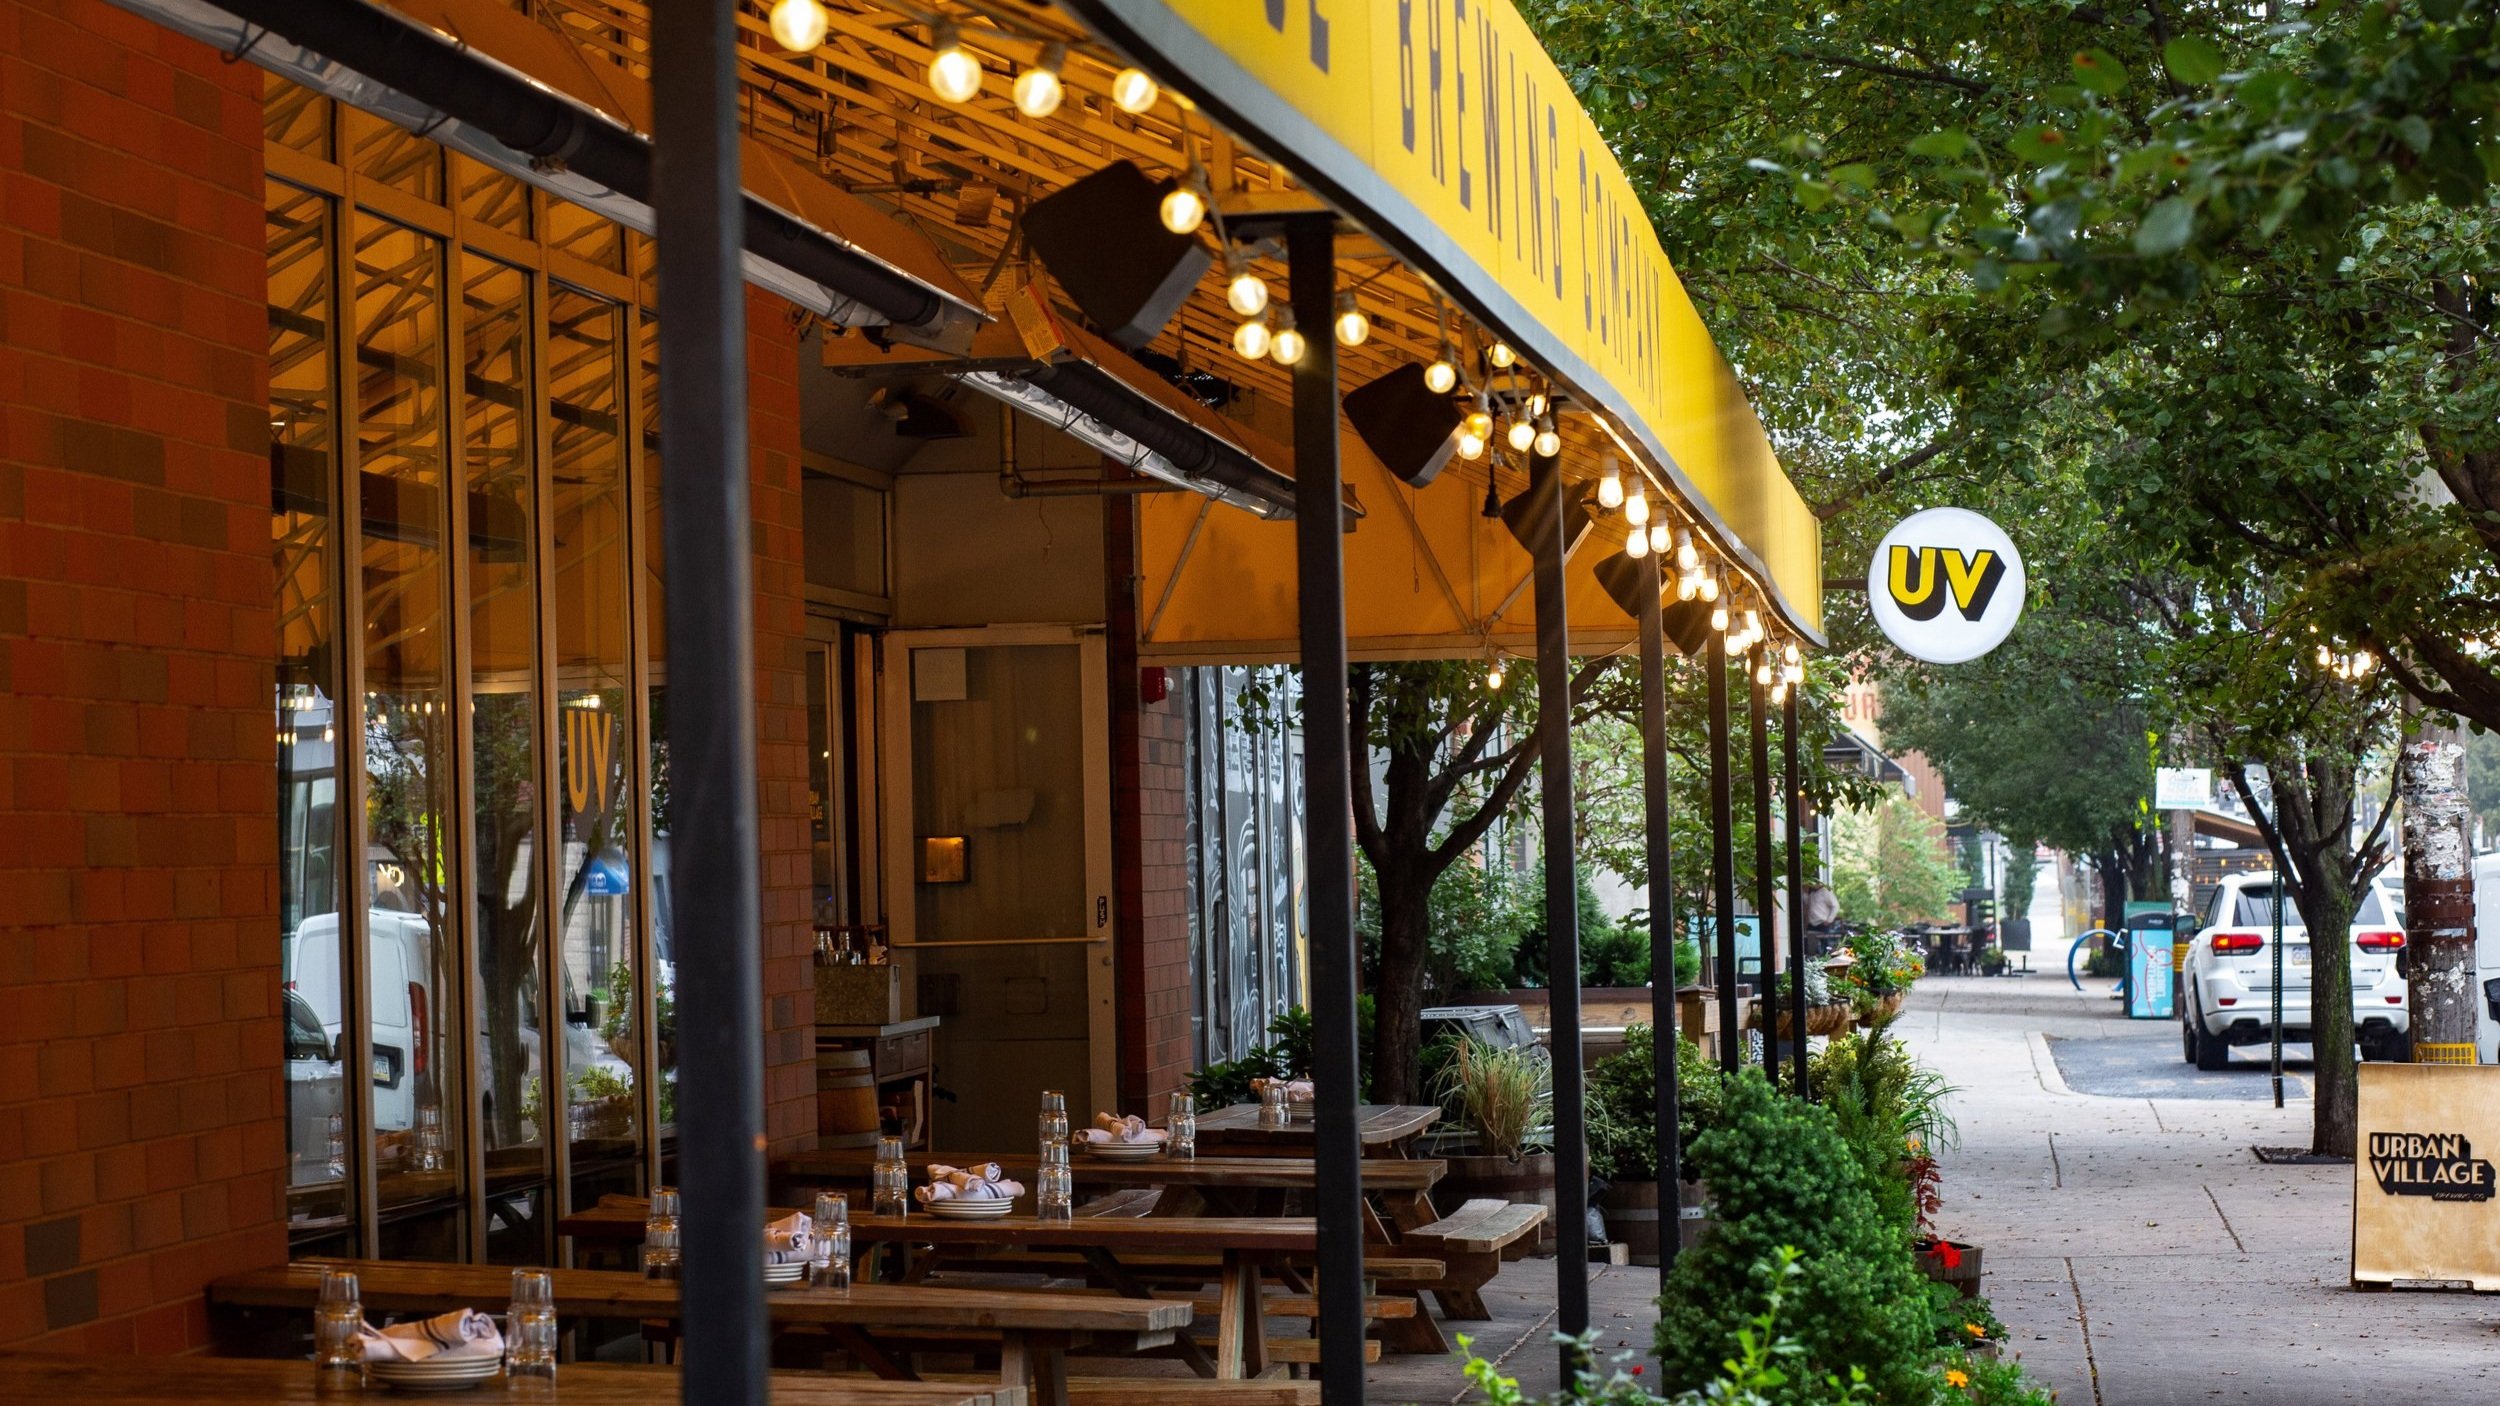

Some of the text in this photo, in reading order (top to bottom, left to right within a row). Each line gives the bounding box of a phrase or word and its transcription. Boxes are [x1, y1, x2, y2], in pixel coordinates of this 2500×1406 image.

[1397, 0, 1663, 419] BREWING COMPANY
[1888, 545, 2006, 622] UV
[566, 709, 613, 814] UV
[2370, 1134, 2462, 1160] URBAN
[2371, 1160, 2485, 1185] VILLAGE
